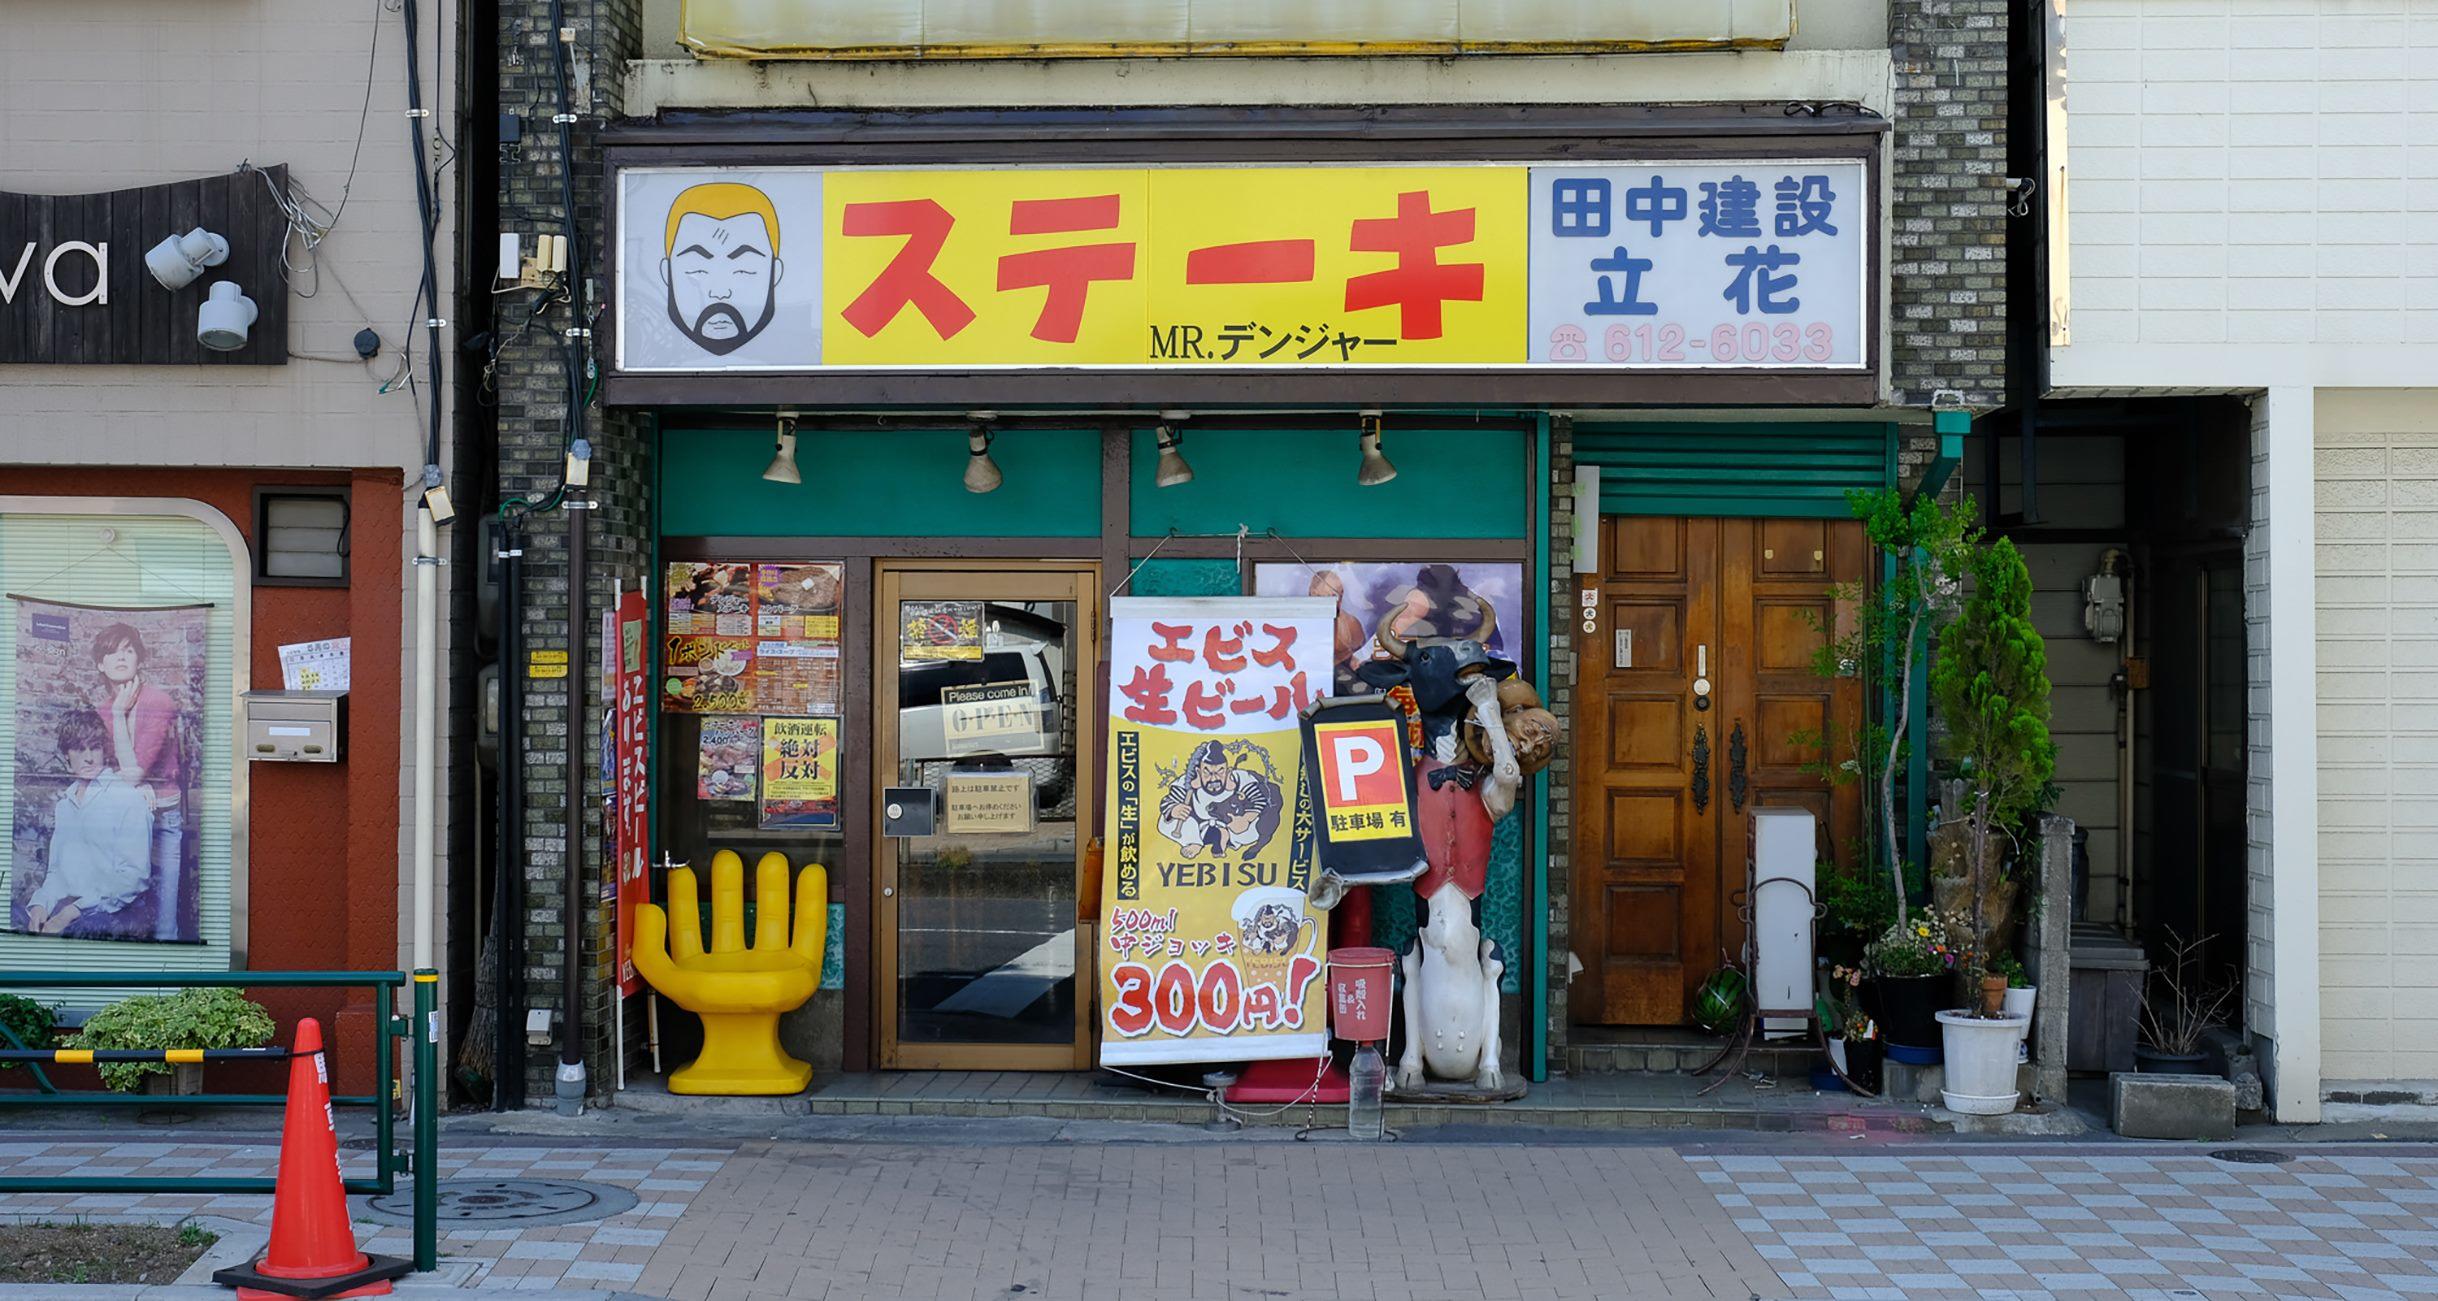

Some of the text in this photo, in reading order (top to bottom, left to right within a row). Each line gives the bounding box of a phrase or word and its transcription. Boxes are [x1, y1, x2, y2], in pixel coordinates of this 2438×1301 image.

[1552, 175, 1839, 238] 田中建設
[840, 190, 1485, 342] ステーキ
[1583, 245, 1801, 316] 立花
[1604, 322, 1833, 362] 612-6033
[1147, 620, 1298, 674] エビス
[948, 691, 985, 702] Please
[987, 688, 1017, 699] come
[1118, 662, 1327, 730] 生ビール
[774, 722, 828, 736] 飲酒運転
[952, 703, 1033, 733] OPEN
[780, 738, 820, 758] 絶対
[632, 674, 647, 879] エビスビール
[780, 760, 820, 780] 反対
[1333, 736, 1386, 801] P
[1120, 733, 1138, 898] エビスの「生」が飲める
[1331, 809, 1407, 832] 駐車場 有
[1156, 862, 1278, 887] YEBISU
[1111, 907, 1177, 932] 500ml
[1110, 932, 1237, 959] 中ジョッキ
